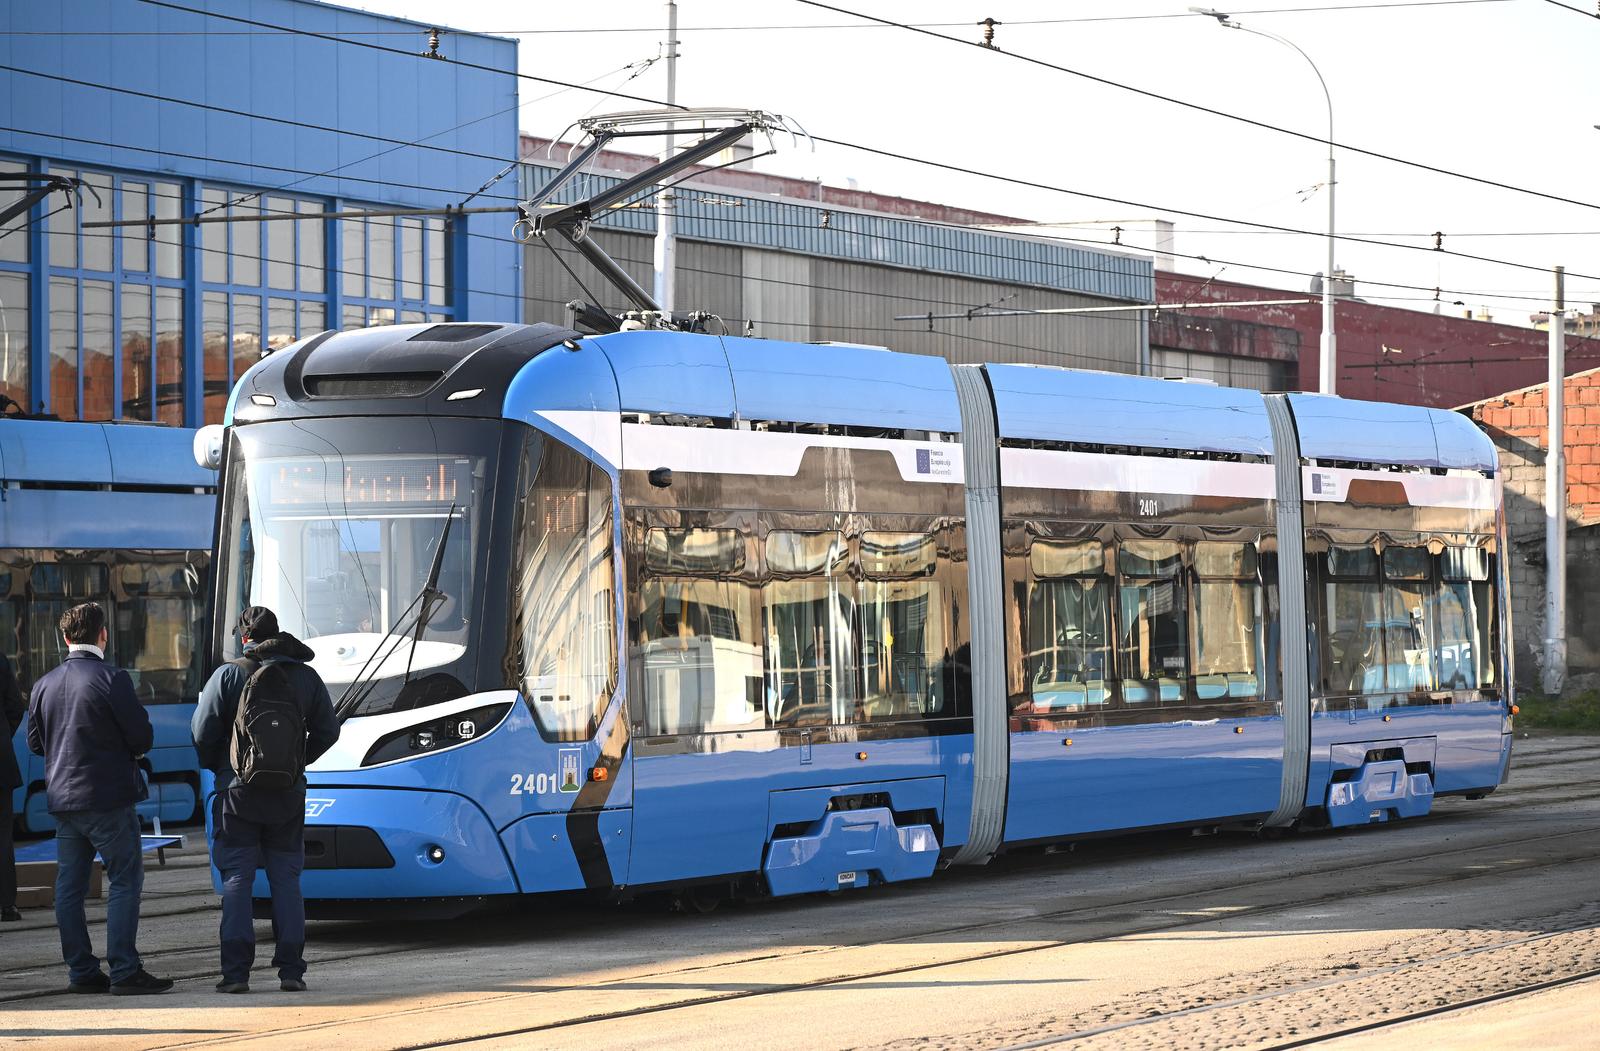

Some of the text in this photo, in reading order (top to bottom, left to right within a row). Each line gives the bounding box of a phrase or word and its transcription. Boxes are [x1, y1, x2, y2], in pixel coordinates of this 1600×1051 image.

[1140, 499, 1158, 516] 2401
[510, 773, 557, 795] 2401
[305, 798, 337, 817] ET
